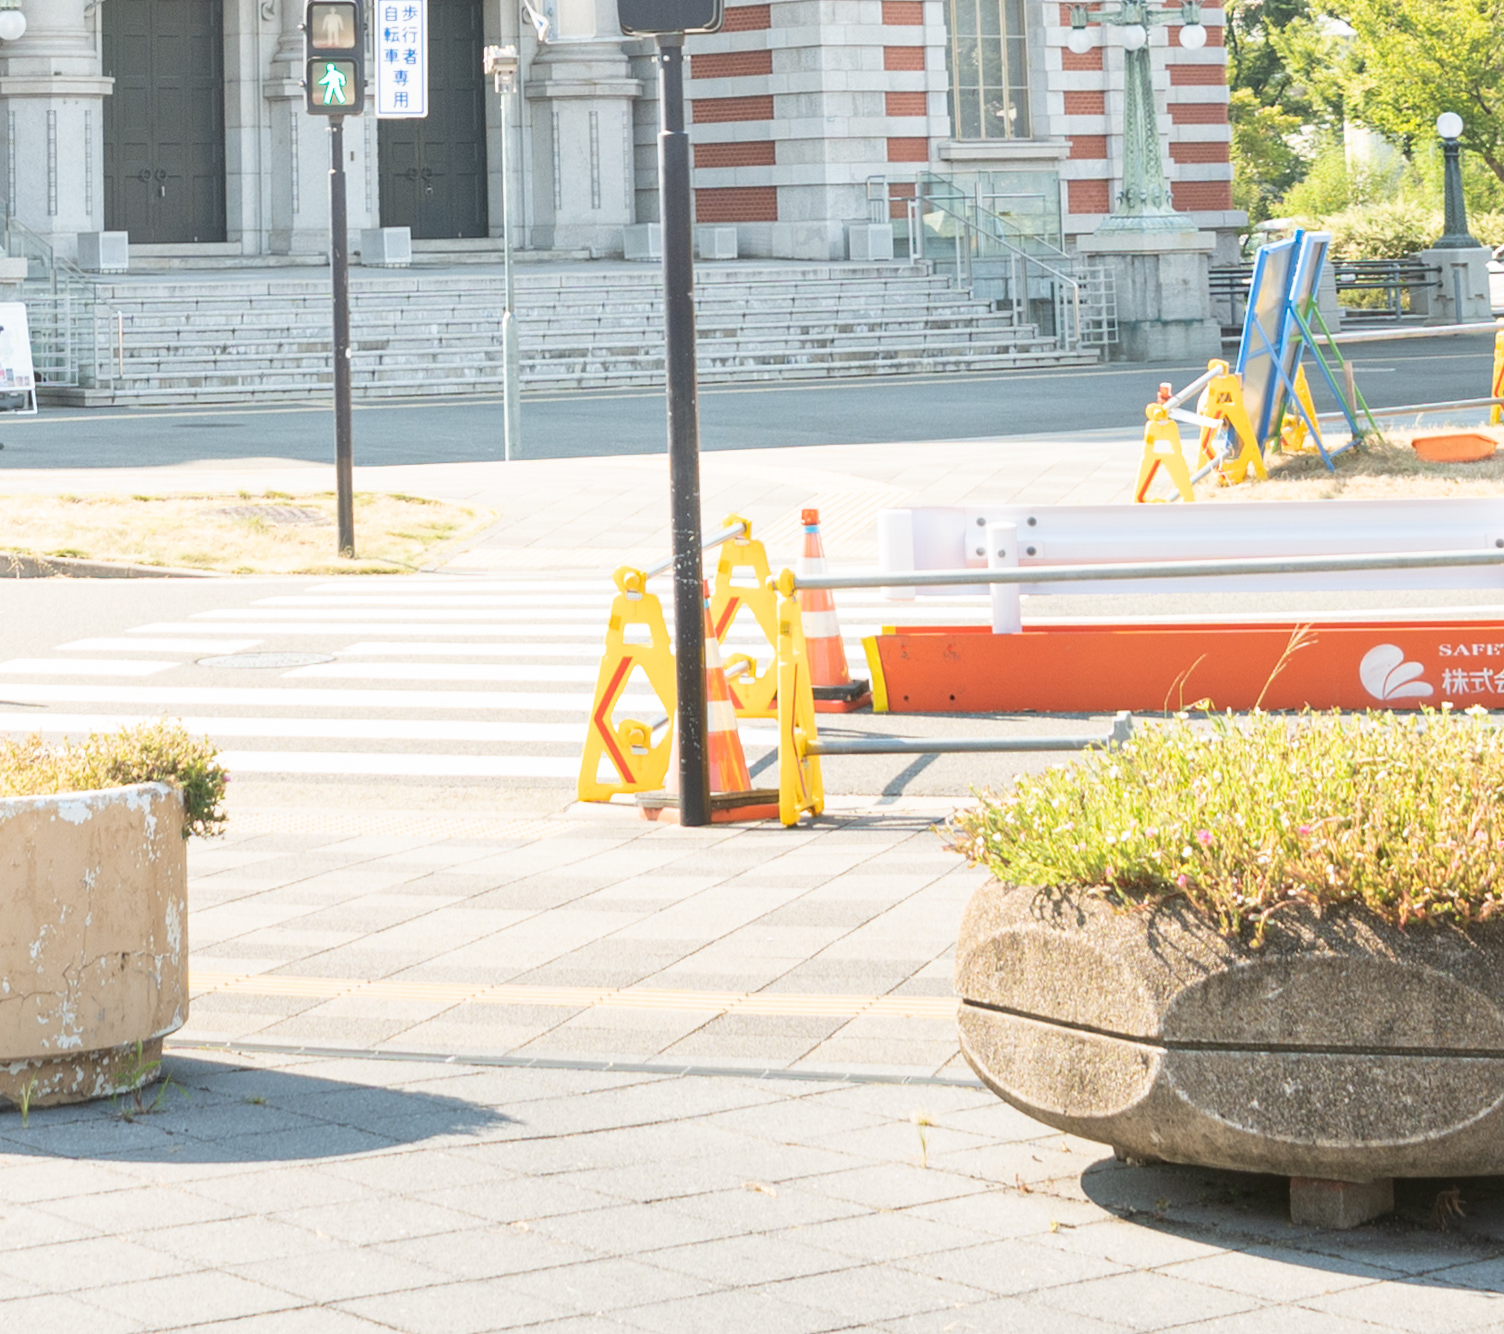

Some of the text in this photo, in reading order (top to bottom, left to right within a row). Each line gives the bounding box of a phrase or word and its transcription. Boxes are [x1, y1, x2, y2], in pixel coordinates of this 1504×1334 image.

[383, 5, 400, 65] 自転車
[402, 5, 419, 65] 歩行者
[393, 69, 410, 109] 専用
